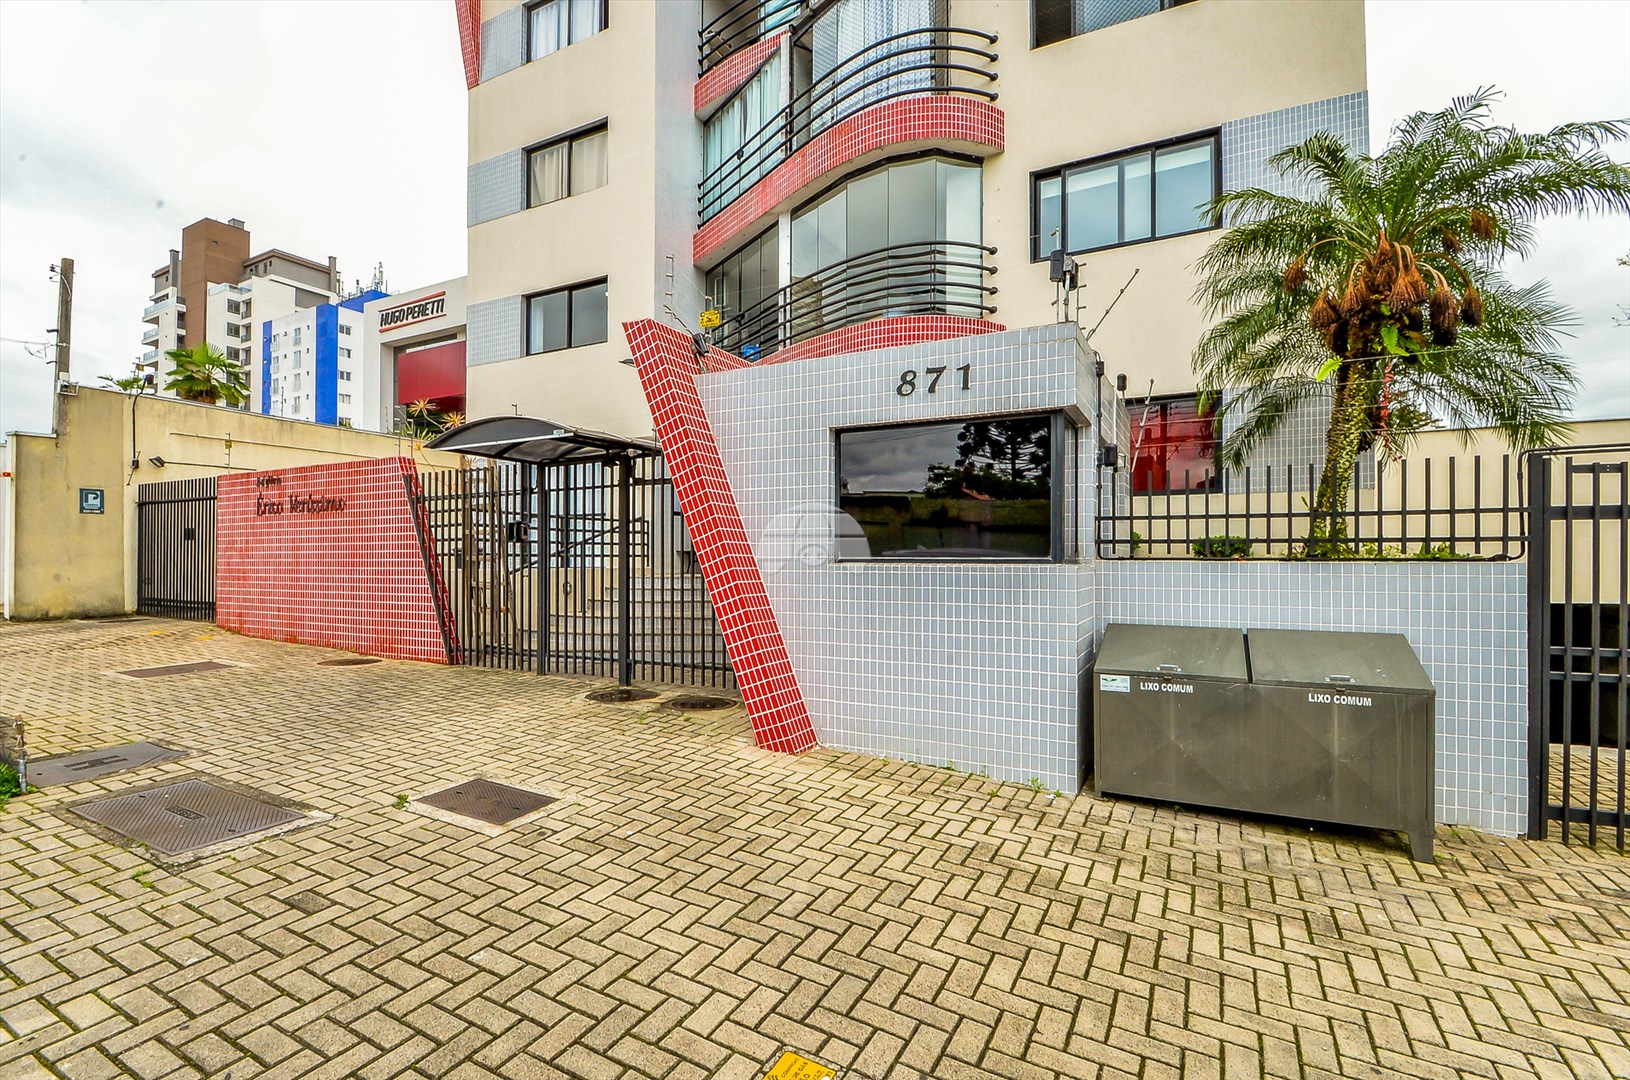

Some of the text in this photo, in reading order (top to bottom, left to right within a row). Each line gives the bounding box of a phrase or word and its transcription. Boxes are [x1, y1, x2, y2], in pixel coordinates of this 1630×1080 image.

[380, 297, 446, 328] HUGO PERETTI
[896, 362, 971, 397] 871
[1140, 681, 1160, 691] LIXO
[1161, 683, 1194, 694] COMUM
[1308, 693, 1372, 707] LIXO COMUM
